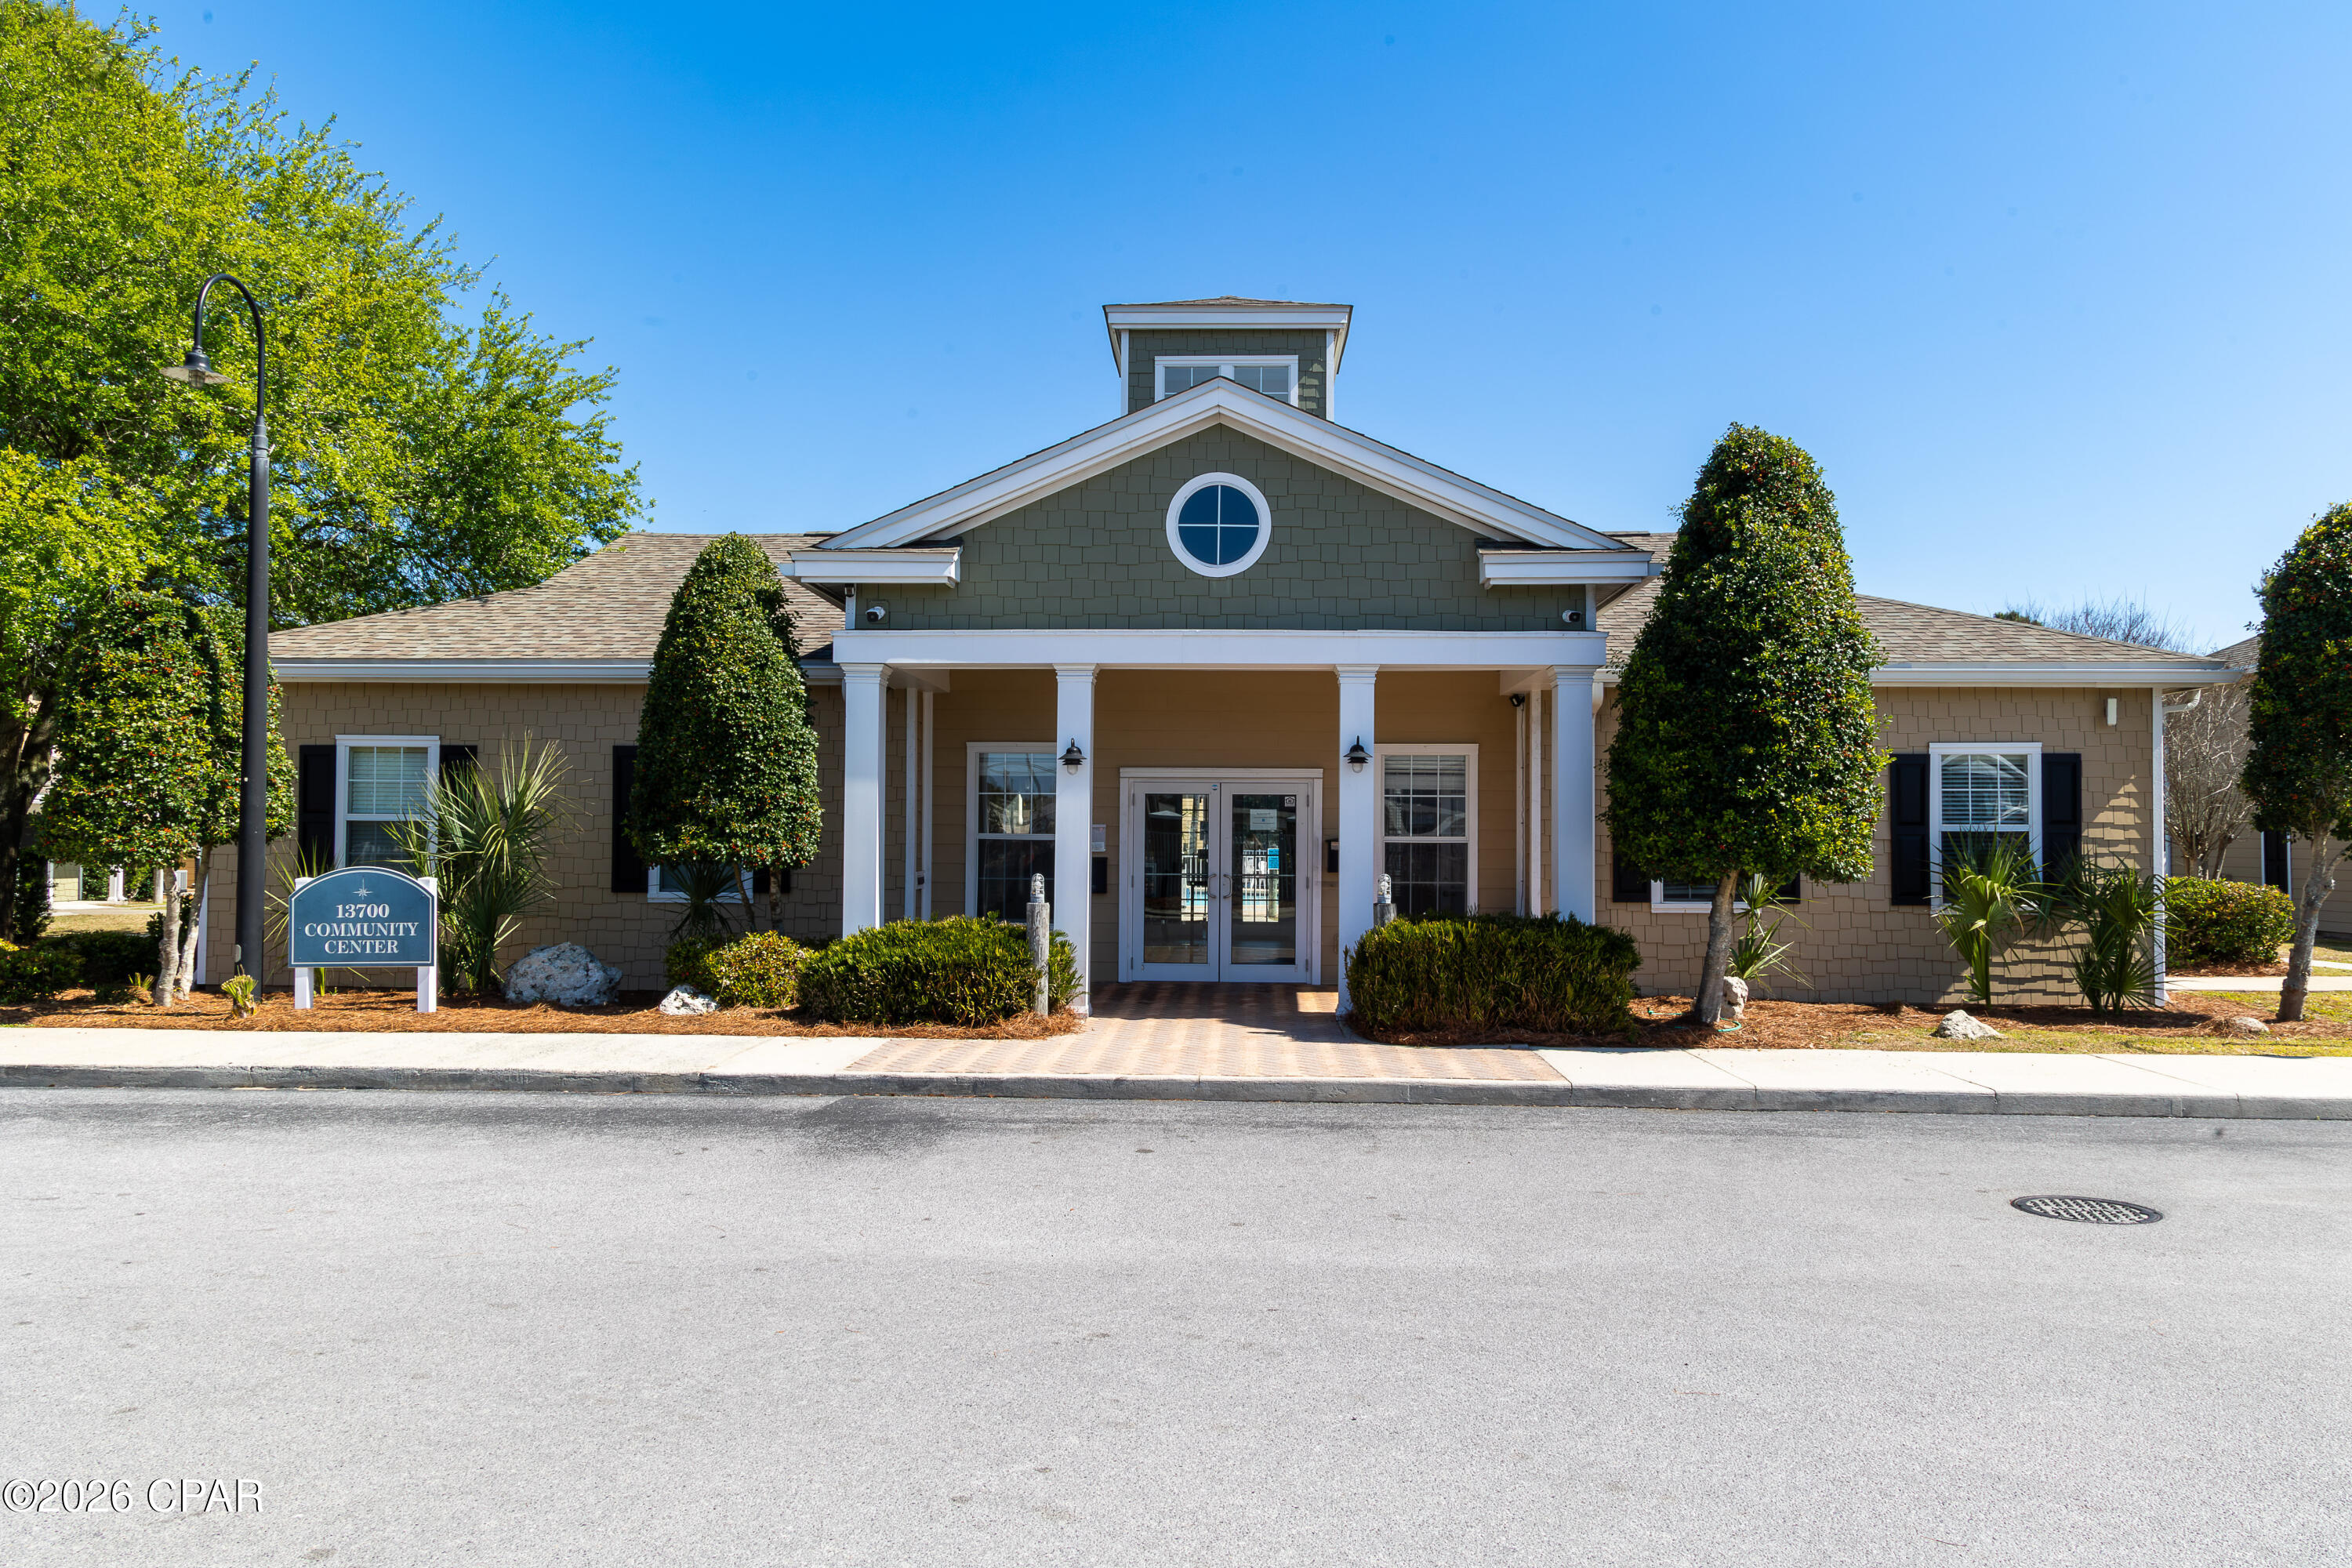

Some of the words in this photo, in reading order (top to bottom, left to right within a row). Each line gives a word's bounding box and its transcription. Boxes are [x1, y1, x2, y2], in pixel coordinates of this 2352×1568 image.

[336, 903, 390, 918] 13700
[304, 922, 419, 937] COMMUNITY
[325, 940, 399, 954] CENTER
